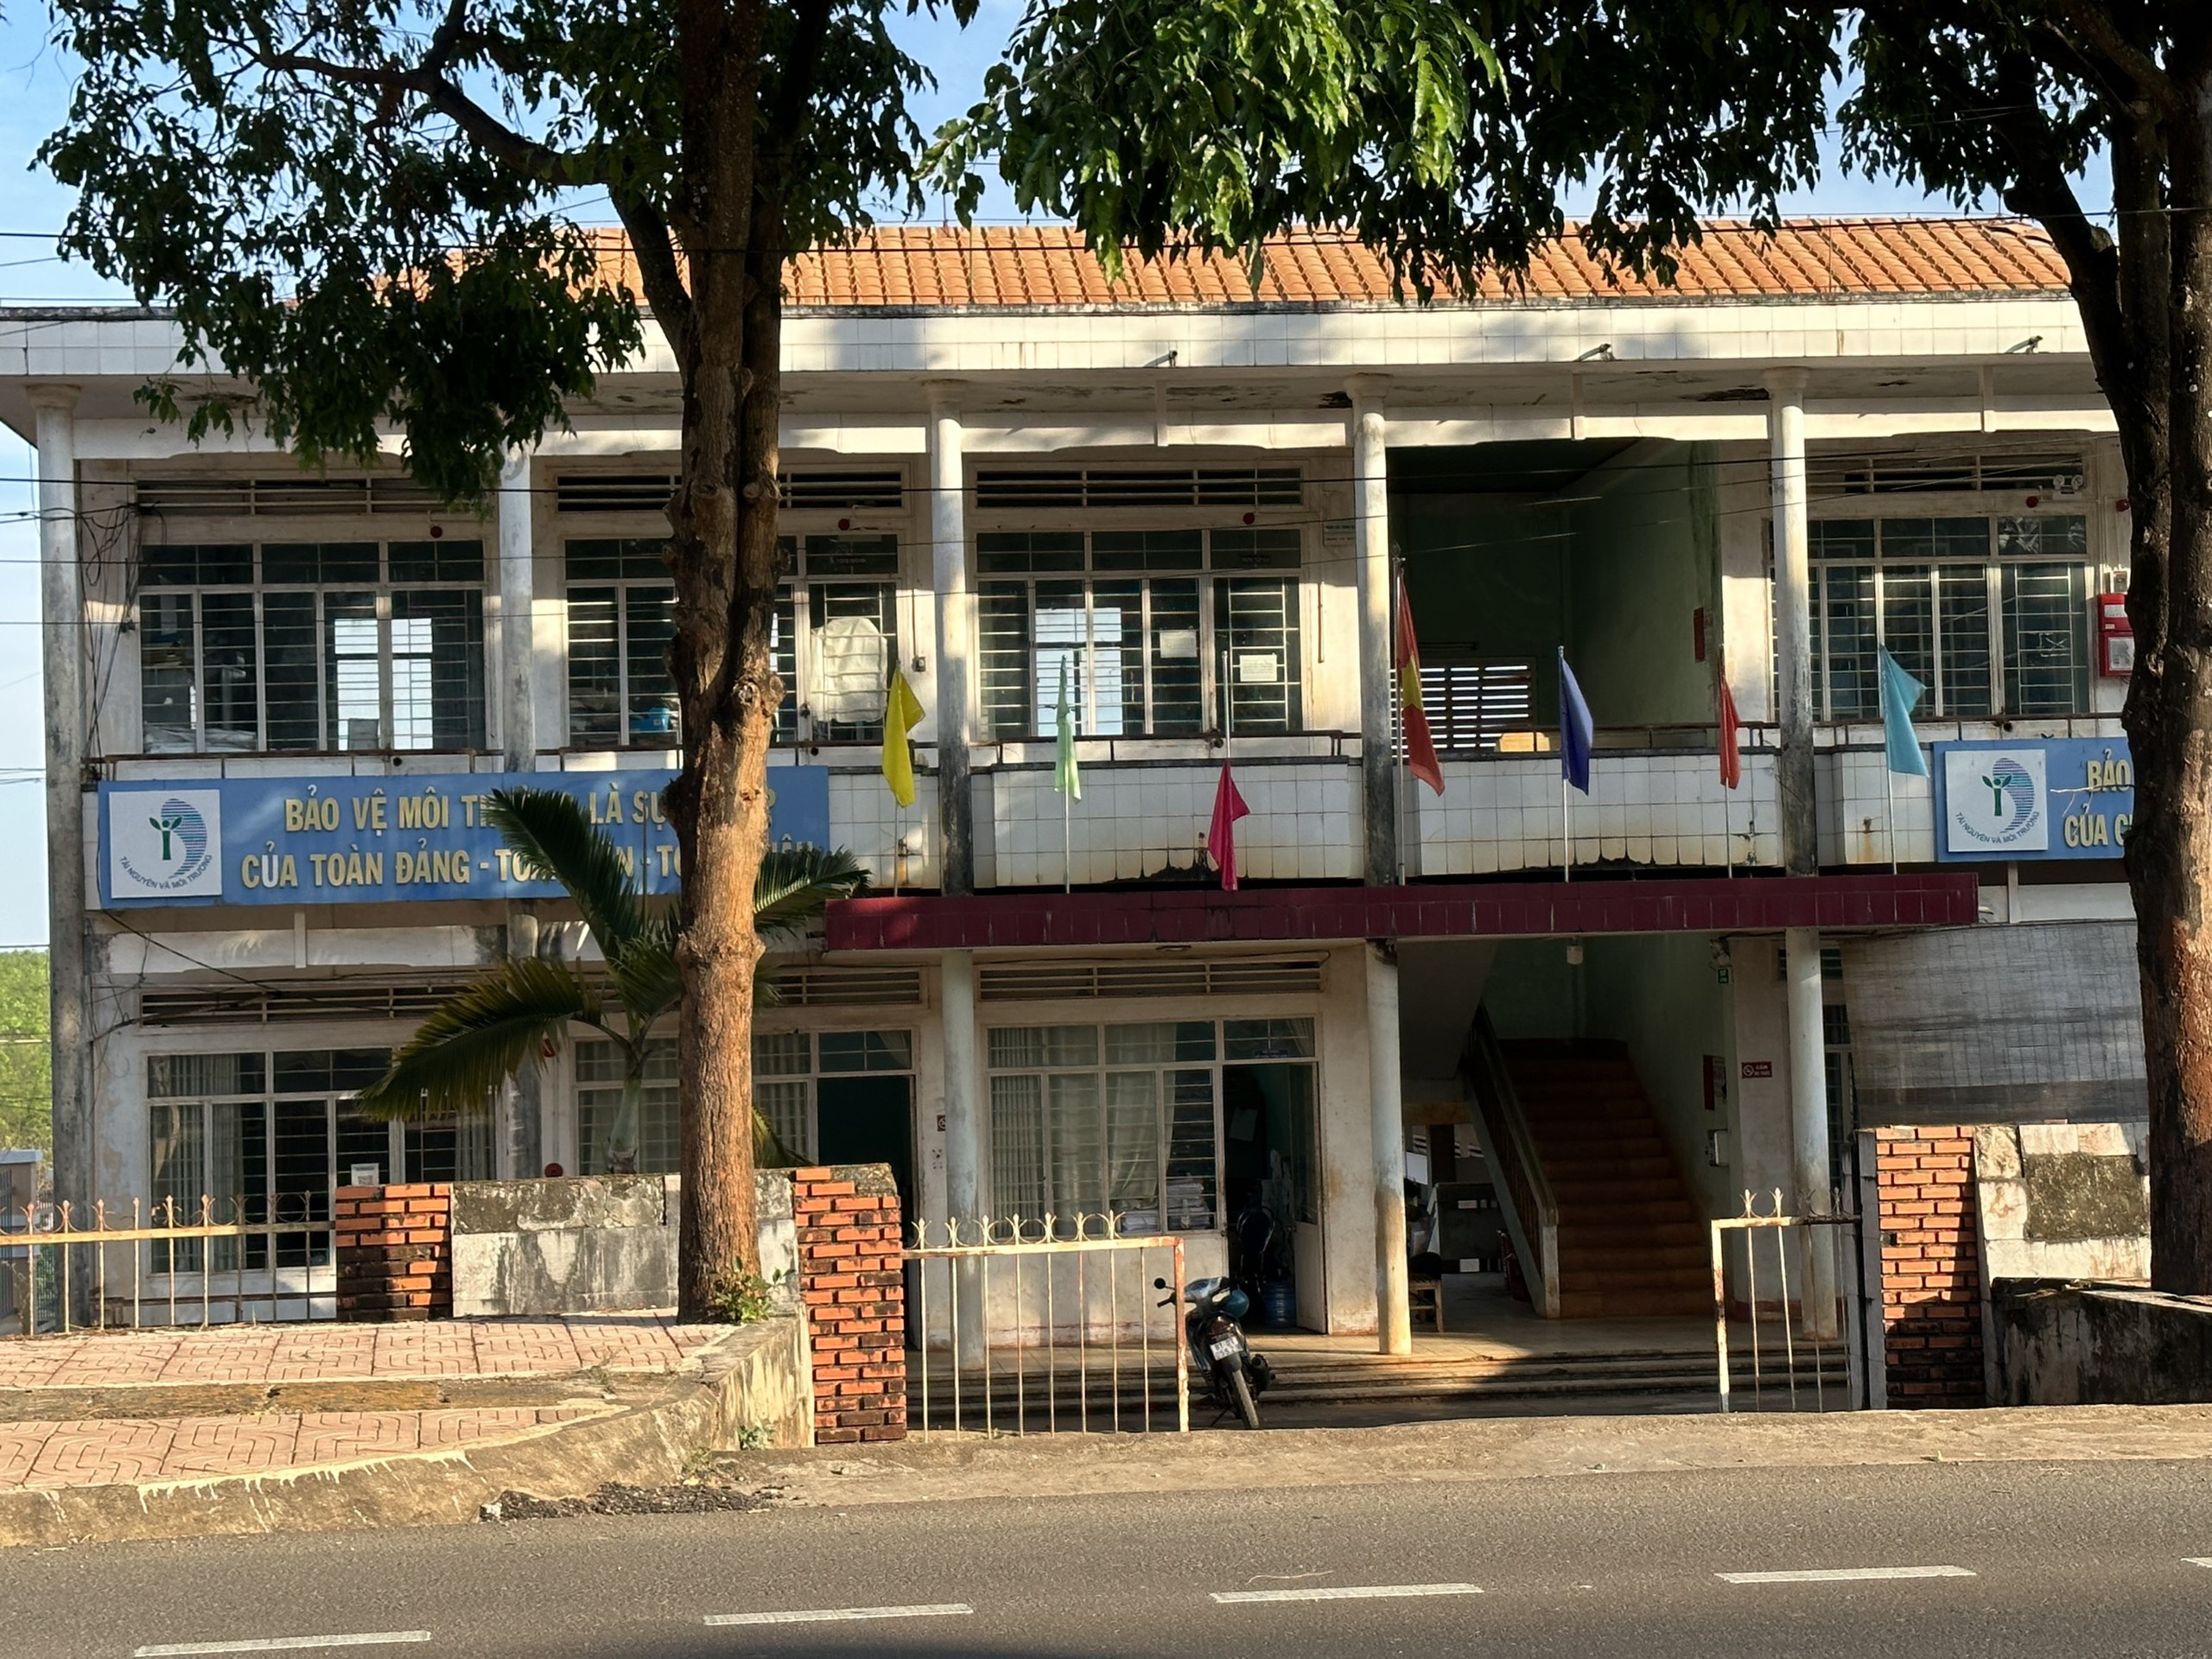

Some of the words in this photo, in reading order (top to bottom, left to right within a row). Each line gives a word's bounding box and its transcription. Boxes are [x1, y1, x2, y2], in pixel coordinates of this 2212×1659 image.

[2087, 747, 2132, 792] BẢO
[285, 784, 340, 832] BẢO
[352, 787, 388, 836] VỆ
[398, 785, 449, 830] MÔI
[588, 781, 623, 824] LÀ
[2064, 803, 2108, 848] CỦA
[241, 840, 298, 888] CỦA
[309, 843, 384, 887] TOÀN
[395, 837, 470, 884] ĐẢNG
